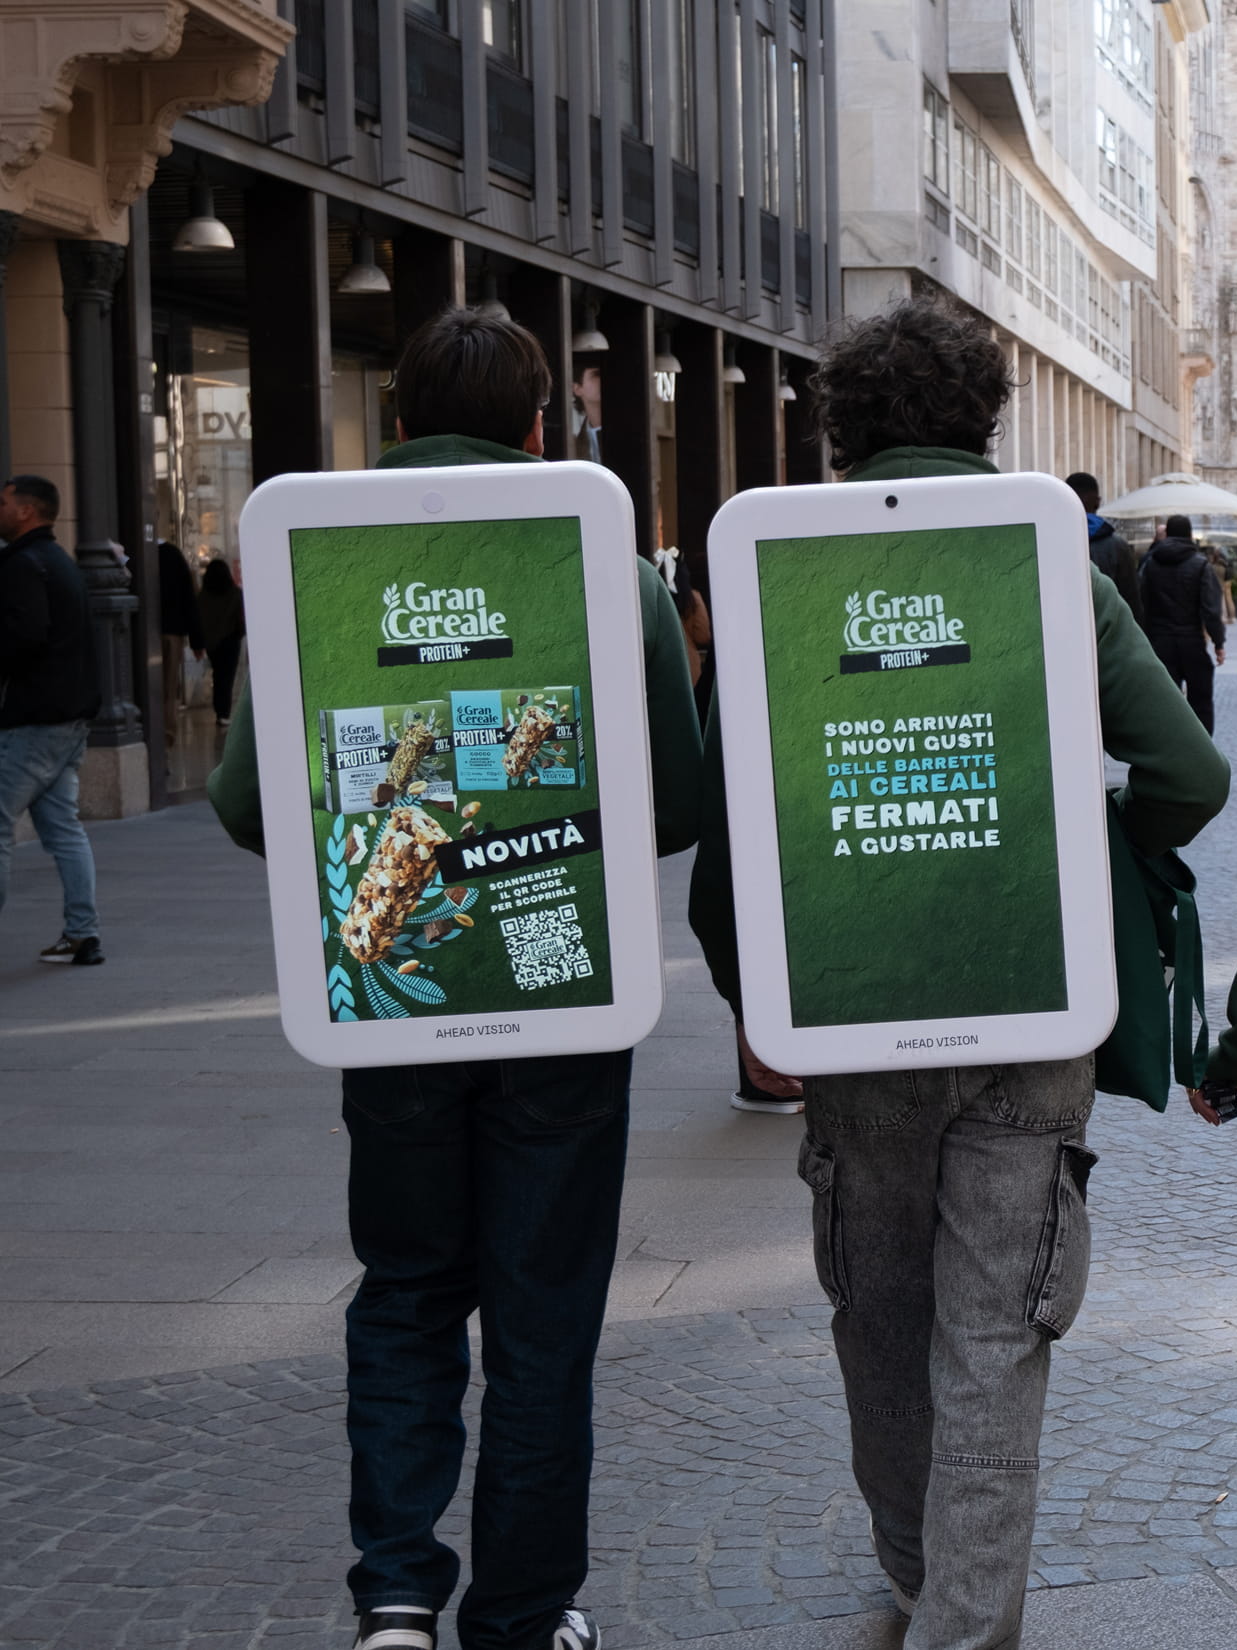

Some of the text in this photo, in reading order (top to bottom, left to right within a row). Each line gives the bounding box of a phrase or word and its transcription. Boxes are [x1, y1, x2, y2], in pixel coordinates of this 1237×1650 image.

[405, 582, 485, 613] Gran
[866, 590, 944, 619] Gran
[388, 608, 507, 640] Cereale
[849, 614, 964, 646] Cereale
[419, 644, 471, 663] PROTEIN+
[880, 650, 930, 669] PROTEIN+
[459, 714, 498, 724] Cereale
[465, 706, 491, 715] Gran
[347, 724, 374, 734] Gran
[556, 726, 572, 737] 20%
[824, 713, 993, 737] SONO ARRIVATI
[341, 732, 382, 744] Cereale
[435, 739, 450, 751] 20%
[453, 729, 505, 746] PROTEIN+
[825, 732, 994, 757] I NUOVI GUSTI
[336, 748, 388, 769] PROTEIN+
[827, 754, 996, 777] DELLE BARRETTE
[829, 770, 996, 799] AI CEREALI
[831, 797, 999, 831] FERMATI
[462, 819, 584, 869] NOVITÀ
[834, 829, 1000, 857] A GUSTARLE
[489, 866, 568, 891] SCANNERIZZA
[491, 886, 577, 913] PER SCOPRIRLE
[500, 879, 563, 900] IL QR CODE
[533, 945, 564, 957] Cereale
[536, 939, 557, 949] Gran
[436, 1023, 520, 1039] AHEAD VISION
[896, 1035, 979, 1049] AHEAD VISION
